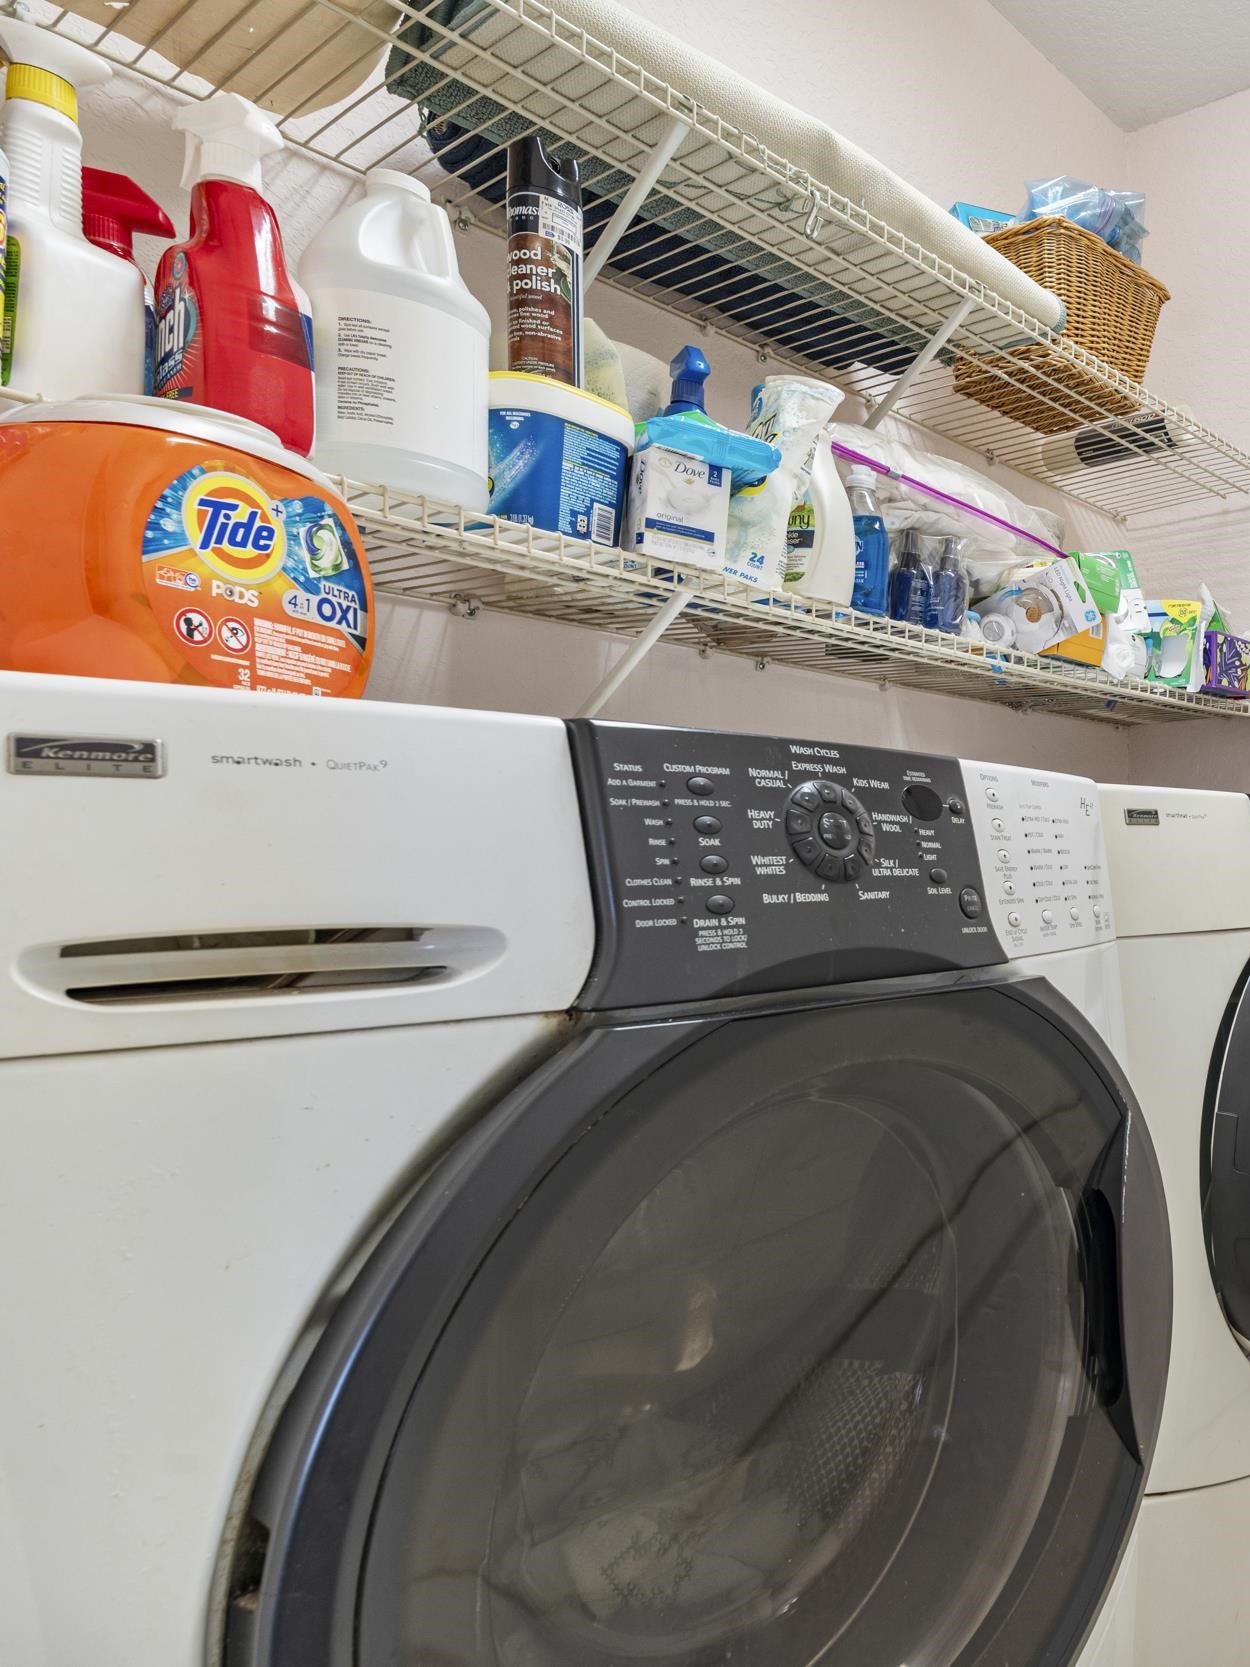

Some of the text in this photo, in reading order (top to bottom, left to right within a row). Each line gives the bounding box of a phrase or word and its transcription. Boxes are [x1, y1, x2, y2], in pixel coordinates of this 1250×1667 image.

[508, 247, 542, 262] ood
[509, 262, 556, 278] leaner
[513, 276, 560, 294] polish
[537, 325, 563, 334] surfaces
[674, 461, 706, 480] Dove
[712, 470, 718, 478] 2
[656, 511, 684, 523] original
[197, 497, 276, 552] Tide
[748, 552, 765, 566] 24
[739, 571, 758, 584] PAKS
[322, 583, 358, 605] ULTRA
[316, 597, 359, 631] OXI
[237, 668, 250, 681] 32
[40, 747, 153, 762] Kenmore
[789, 745, 840, 758] WASH CYCLES
[211, 754, 302, 767] smartwash
[22, 761, 152, 773] ELITE
[613, 763, 643, 772] STATUS
[663, 763, 731, 775] CUSTOM PROGRAM
[791, 761, 847, 774] EXPRESS WASH
[748, 768, 784, 779] NORMAL
[755, 779, 785, 789] CASUAL
[852, 777, 889, 789] KIDS WEAR
[609, 798, 660, 807] SOAK PREWASH
[674, 798, 693, 806] PRESS
[699, 799, 715, 807] HOLD
[747, 809, 775, 820] HEAVY
[872, 812, 909, 823] HANDWASH
[643, 818, 664, 826] WASH
[753, 819, 773, 829] DUTY
[881, 823, 902, 832] WOOL
[648, 838, 667, 846] RINSE
[698, 838, 721, 847] SOAK
[655, 857, 670, 866] SPIN
[751, 856, 787, 866] WHITEST
[923, 853, 937, 861] LIGHT
[880, 858, 895, 867] SILK
[755, 866, 786, 875] WHITES
[872, 868, 919, 876] ULTRA DELICATE
[625, 878, 673, 887] CLOTHES CLEAN
[690, 878, 714, 887] RINSE
[724, 877, 741, 886] SPIN
[858, 891, 890, 900] SANITARY
[927, 887, 938, 895] SOIL
[622, 898, 675, 907] CONTROL LOCKED
[762, 893, 829, 903] BULKY BEDDING
[635, 918, 677, 928] DOOR LOCKED
[693, 919, 718, 928] DRAIN
[728, 917, 746, 926] SPIN
[698, 929, 717, 937] PRESS
[697, 942, 748, 952] UNLOCK CONTROL
